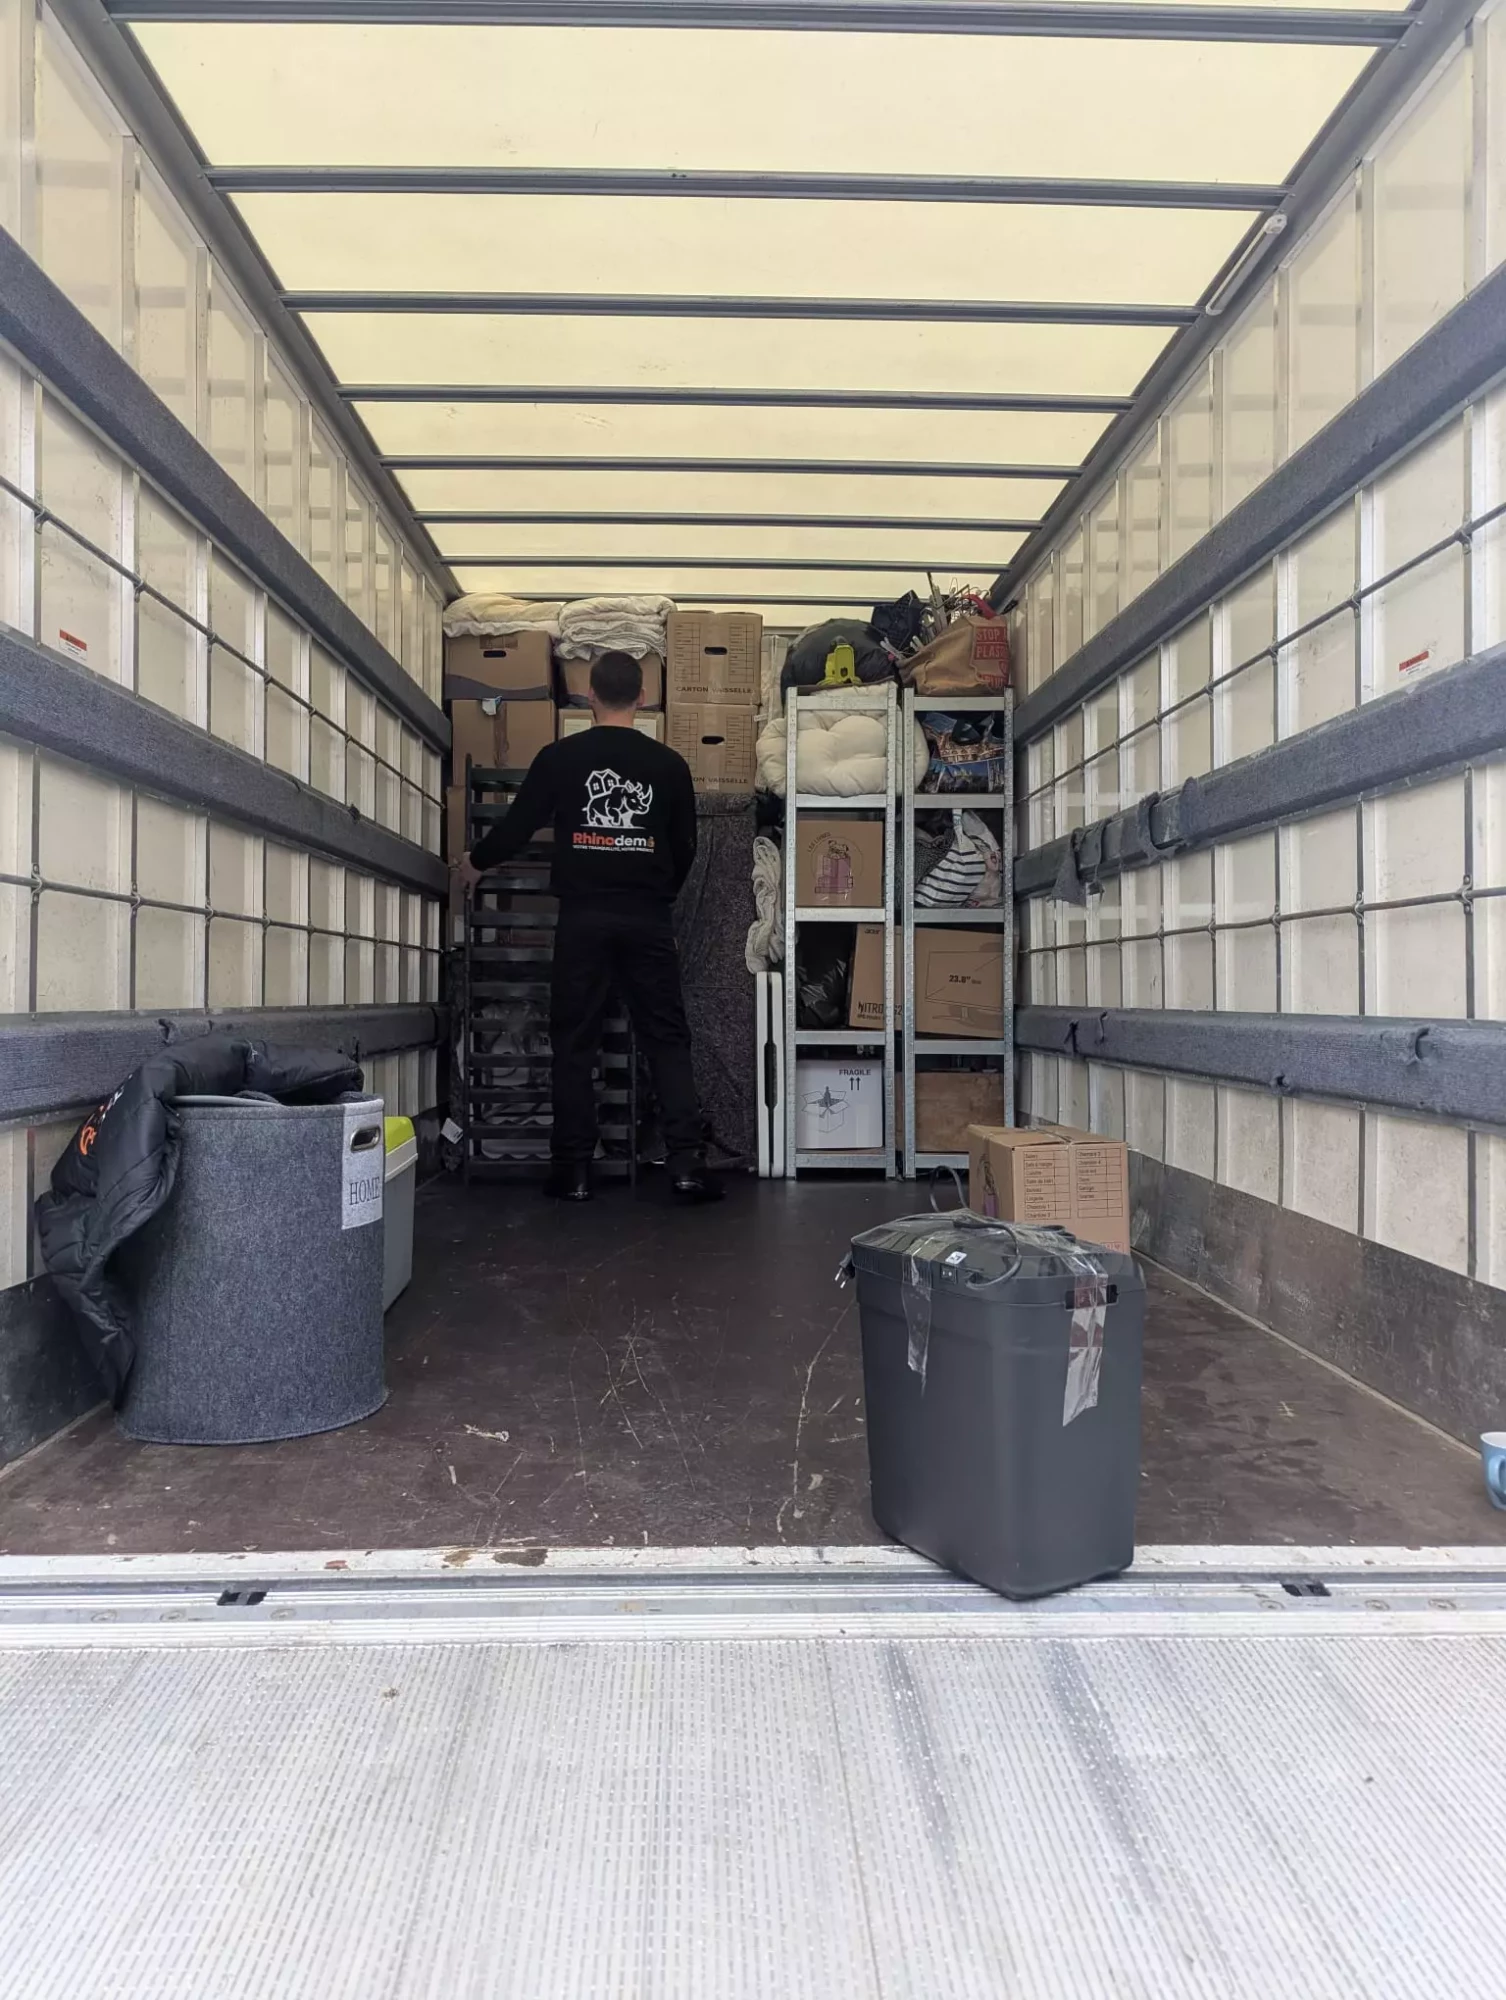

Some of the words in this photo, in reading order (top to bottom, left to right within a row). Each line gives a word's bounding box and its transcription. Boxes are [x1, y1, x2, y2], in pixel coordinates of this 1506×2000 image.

[976, 628, 1000, 642] STOP
[858, 1001, 884, 1014] NITRO
[349, 1176, 380, 1206] HOME
